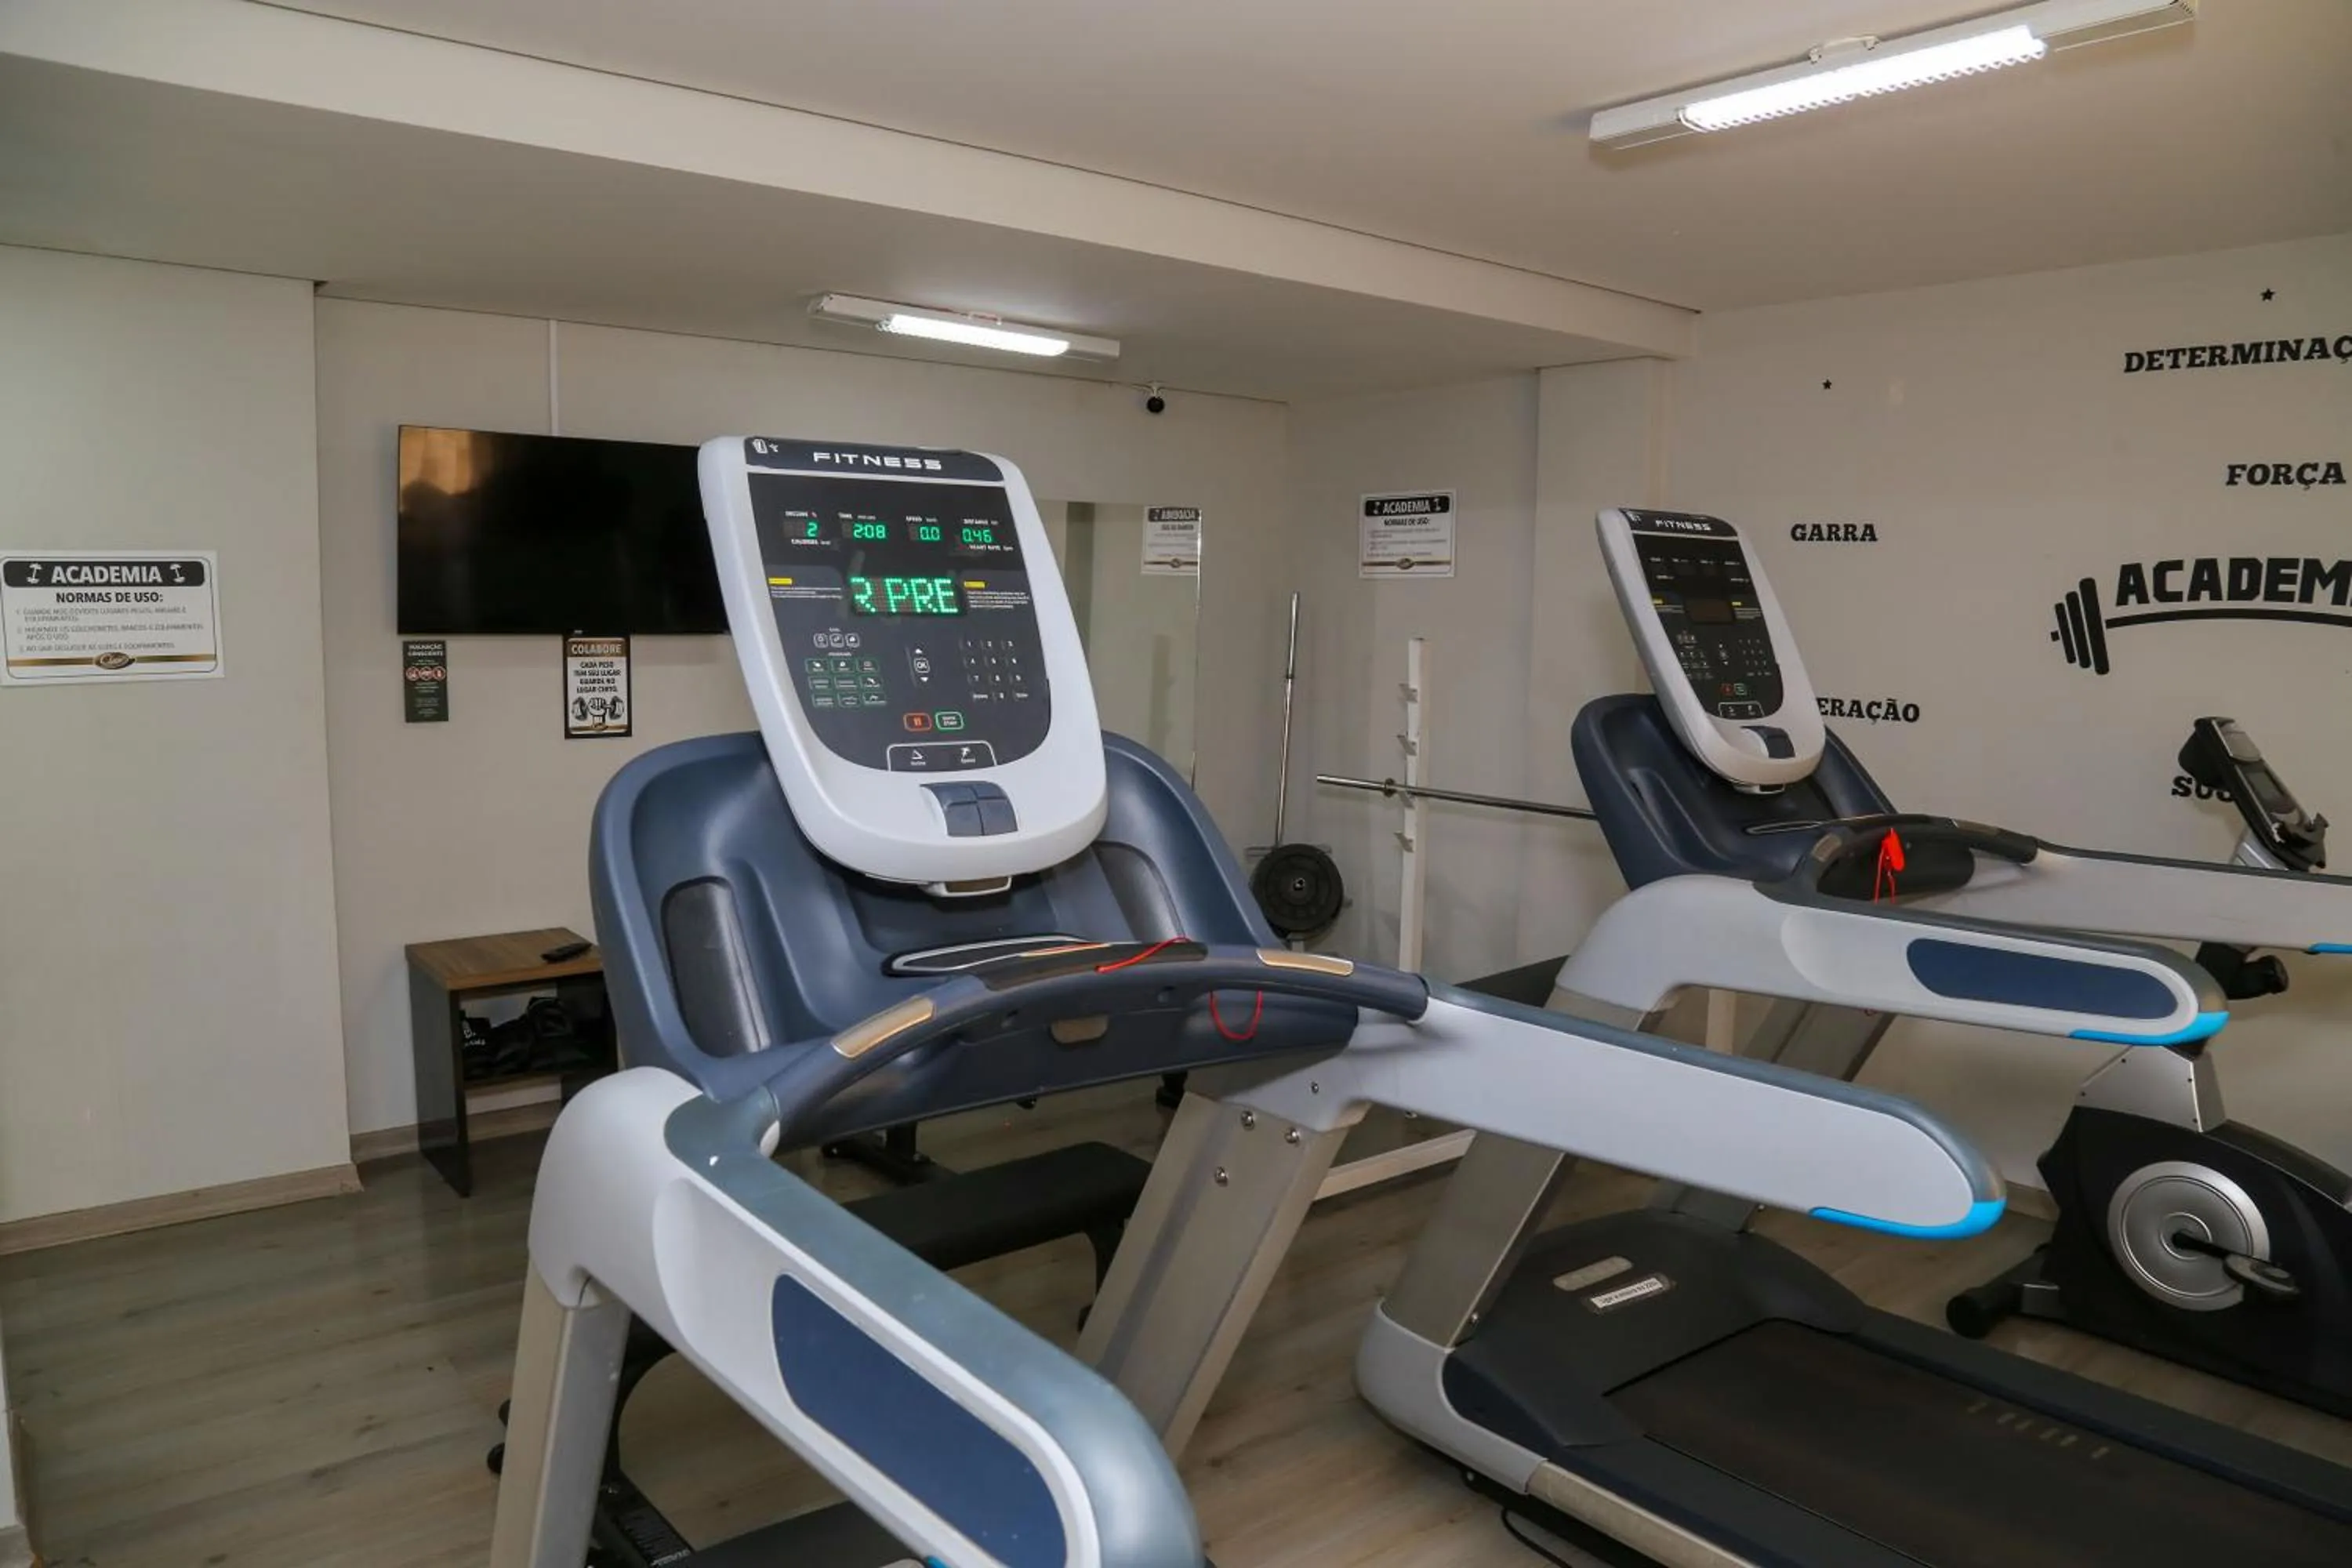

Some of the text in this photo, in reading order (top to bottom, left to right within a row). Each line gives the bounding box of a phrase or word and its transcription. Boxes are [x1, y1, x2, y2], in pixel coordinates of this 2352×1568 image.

[2123, 336, 2352, 373] DETERMINAÇ
[813, 452, 942, 470] FITNESS
[2225, 462, 2347, 490] FORÇA
[1382, 500, 1431, 514] ACADEMIA
[807, 521, 818, 538] 2
[1655, 519, 1712, 531] FITNESS
[1790, 523, 1878, 543] GARRA
[51, 565, 163, 584] ACADEMIA
[2115, 557, 2352, 608] ACADEM
[56, 591, 164, 603] NORMAS DE USO:
[884, 577, 959, 615] PRE
